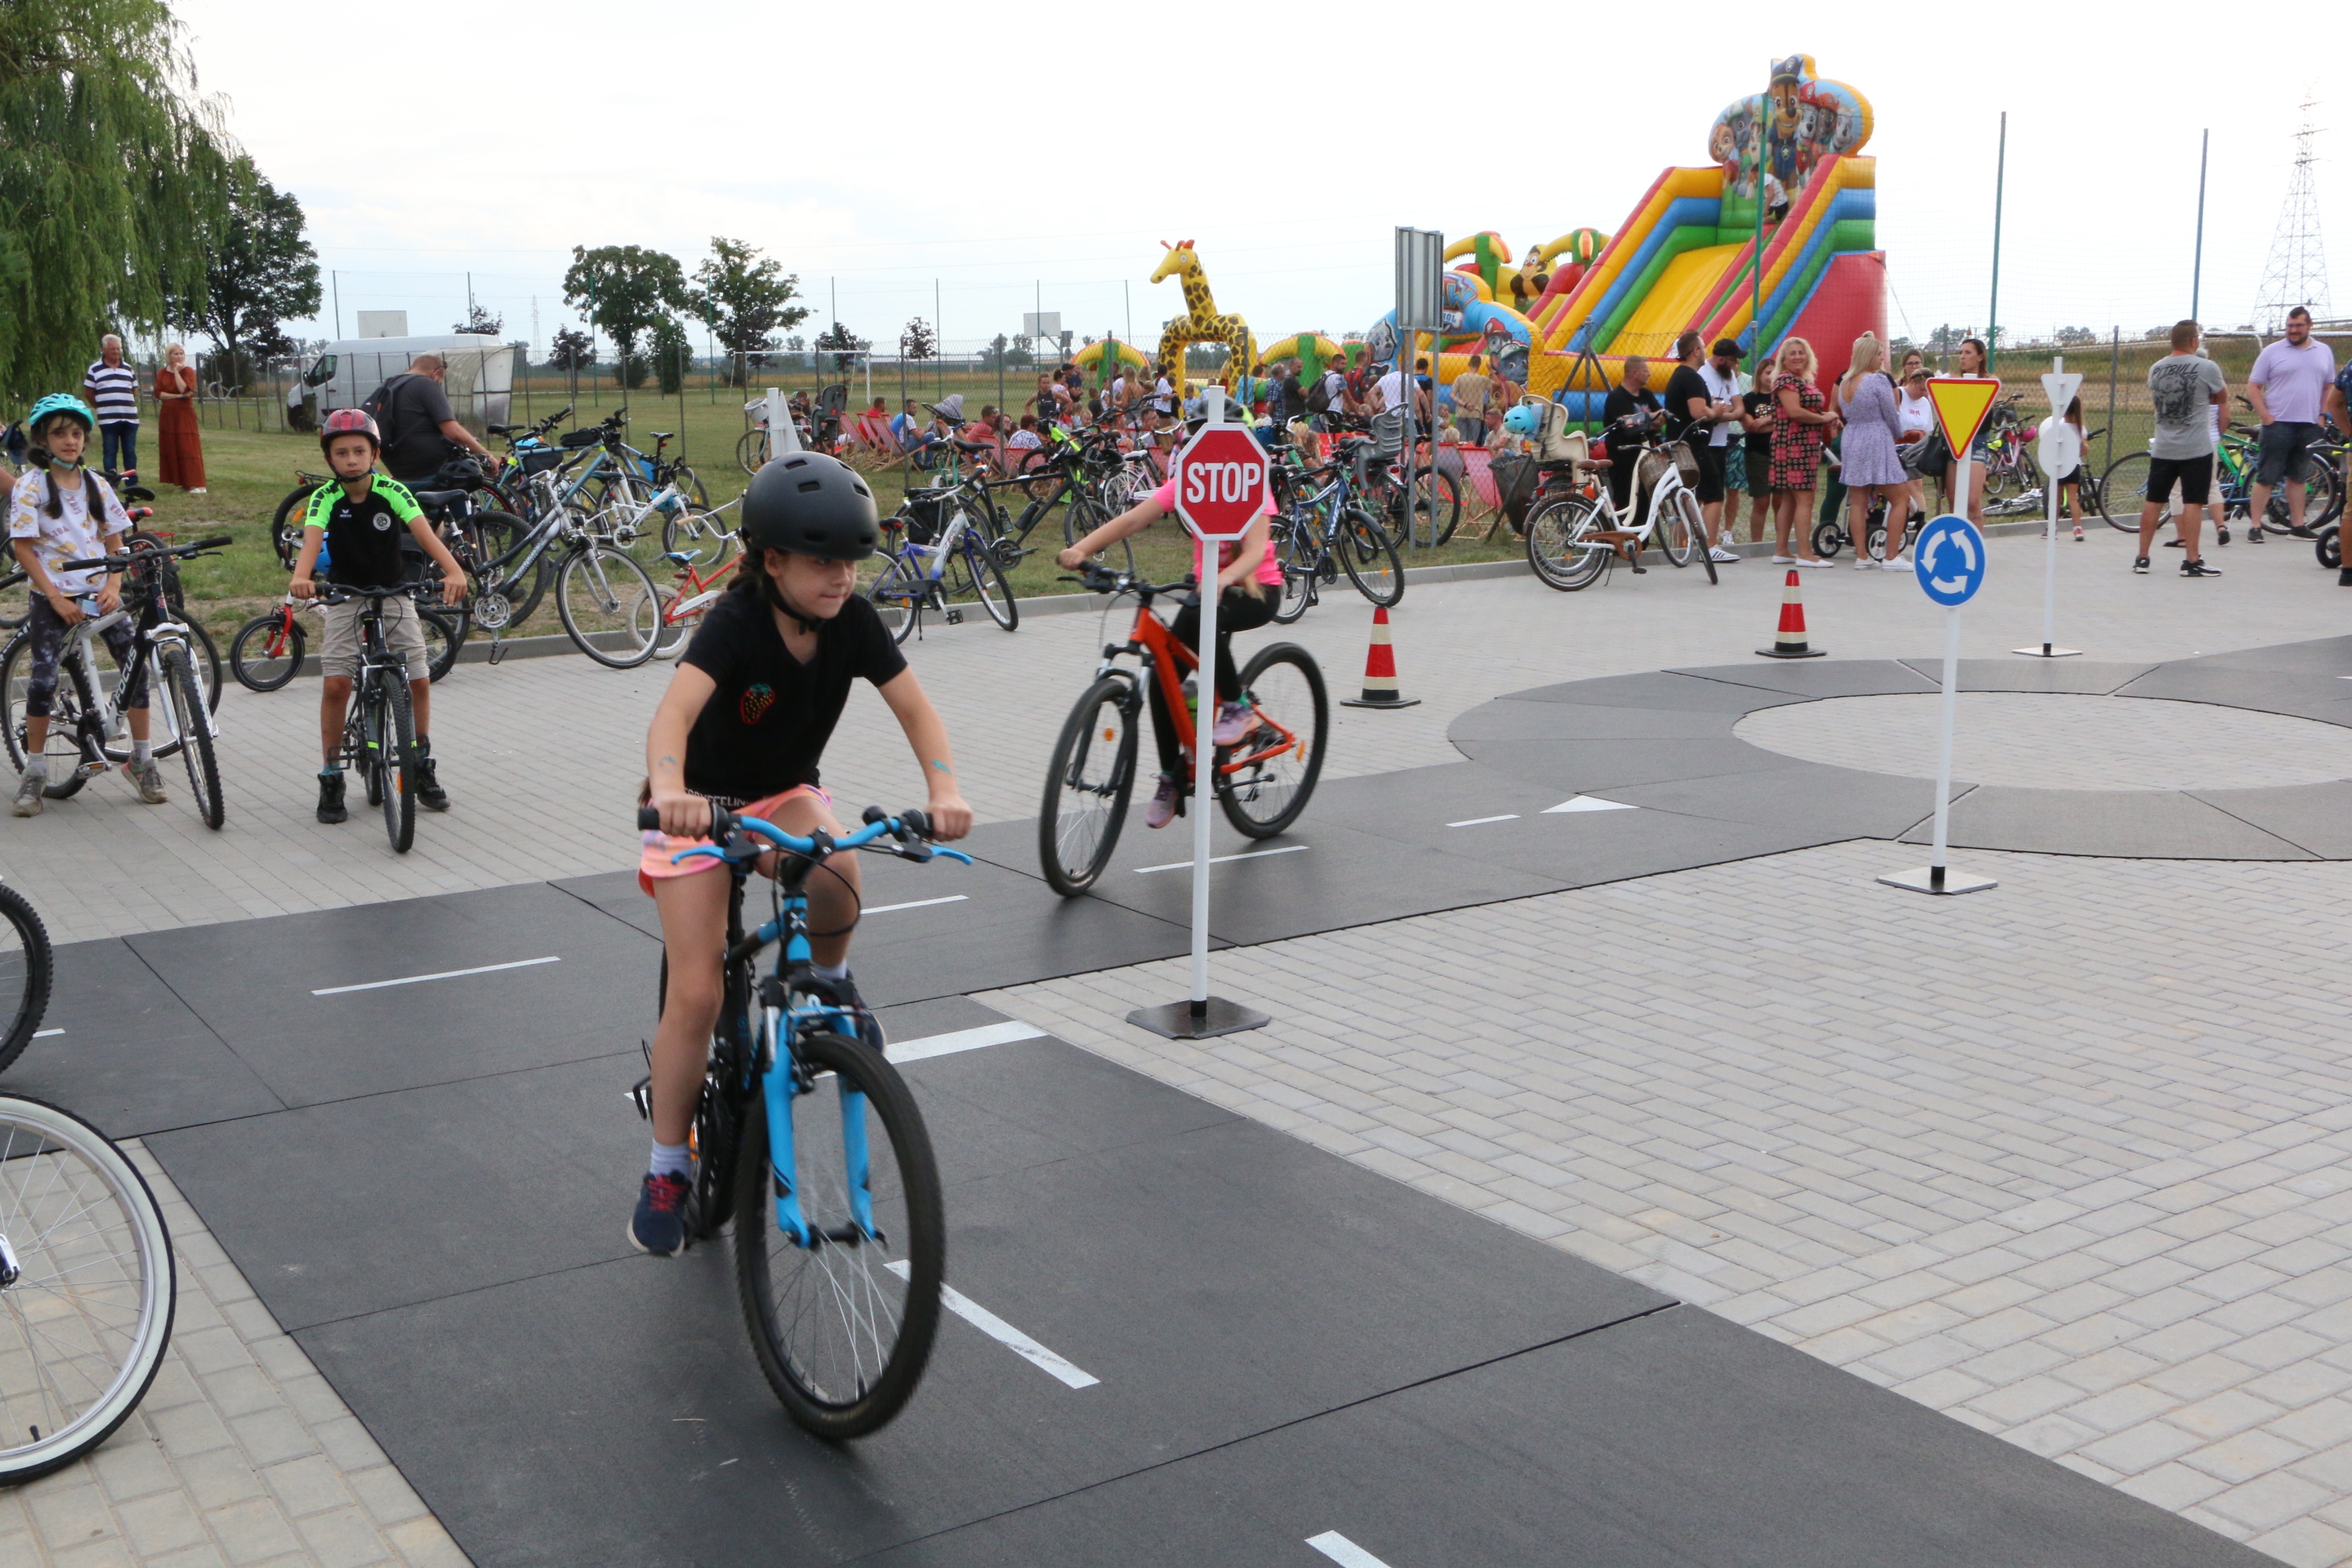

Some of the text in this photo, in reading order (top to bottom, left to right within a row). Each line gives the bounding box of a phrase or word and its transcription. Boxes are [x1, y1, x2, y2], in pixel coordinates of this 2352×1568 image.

[2152, 363, 2199, 379] PITBULL
[1186, 462, 1261, 504] STOP
[114, 645, 137, 704] FOCUS
